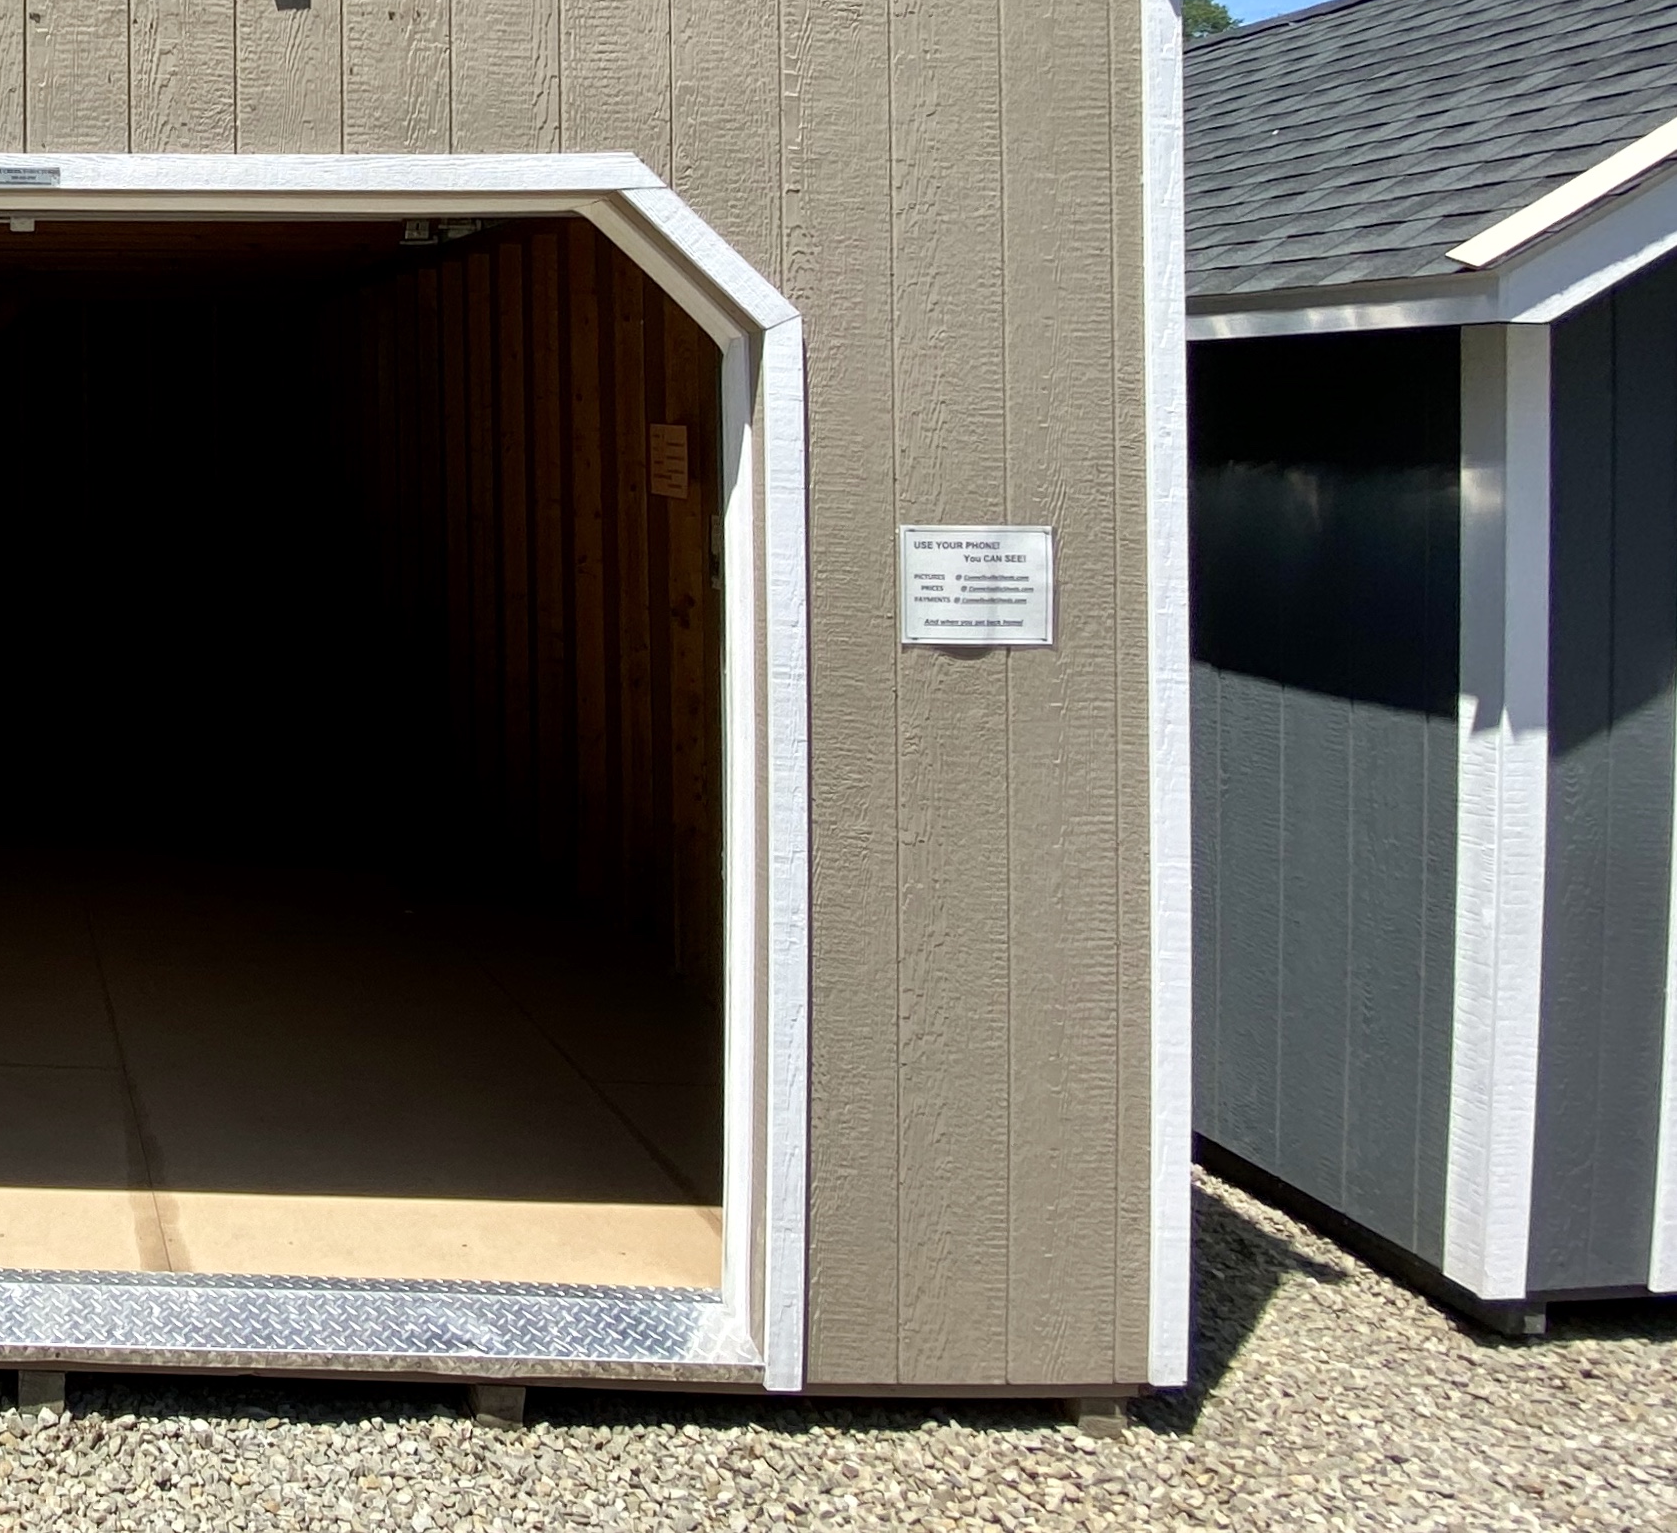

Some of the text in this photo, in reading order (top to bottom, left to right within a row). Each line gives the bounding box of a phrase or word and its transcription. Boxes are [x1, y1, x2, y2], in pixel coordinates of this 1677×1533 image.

[913, 541, 1001, 550] USE YOUR PHONE!
[963, 554, 1026, 563] You CAN SEE!
[914, 573, 945, 581] PICTURES
[955, 573, 962, 581] @
[960, 585, 967, 593] @
[924, 618, 939, 626] And
[940, 618, 959, 626] when
[960, 619, 972, 627] you
